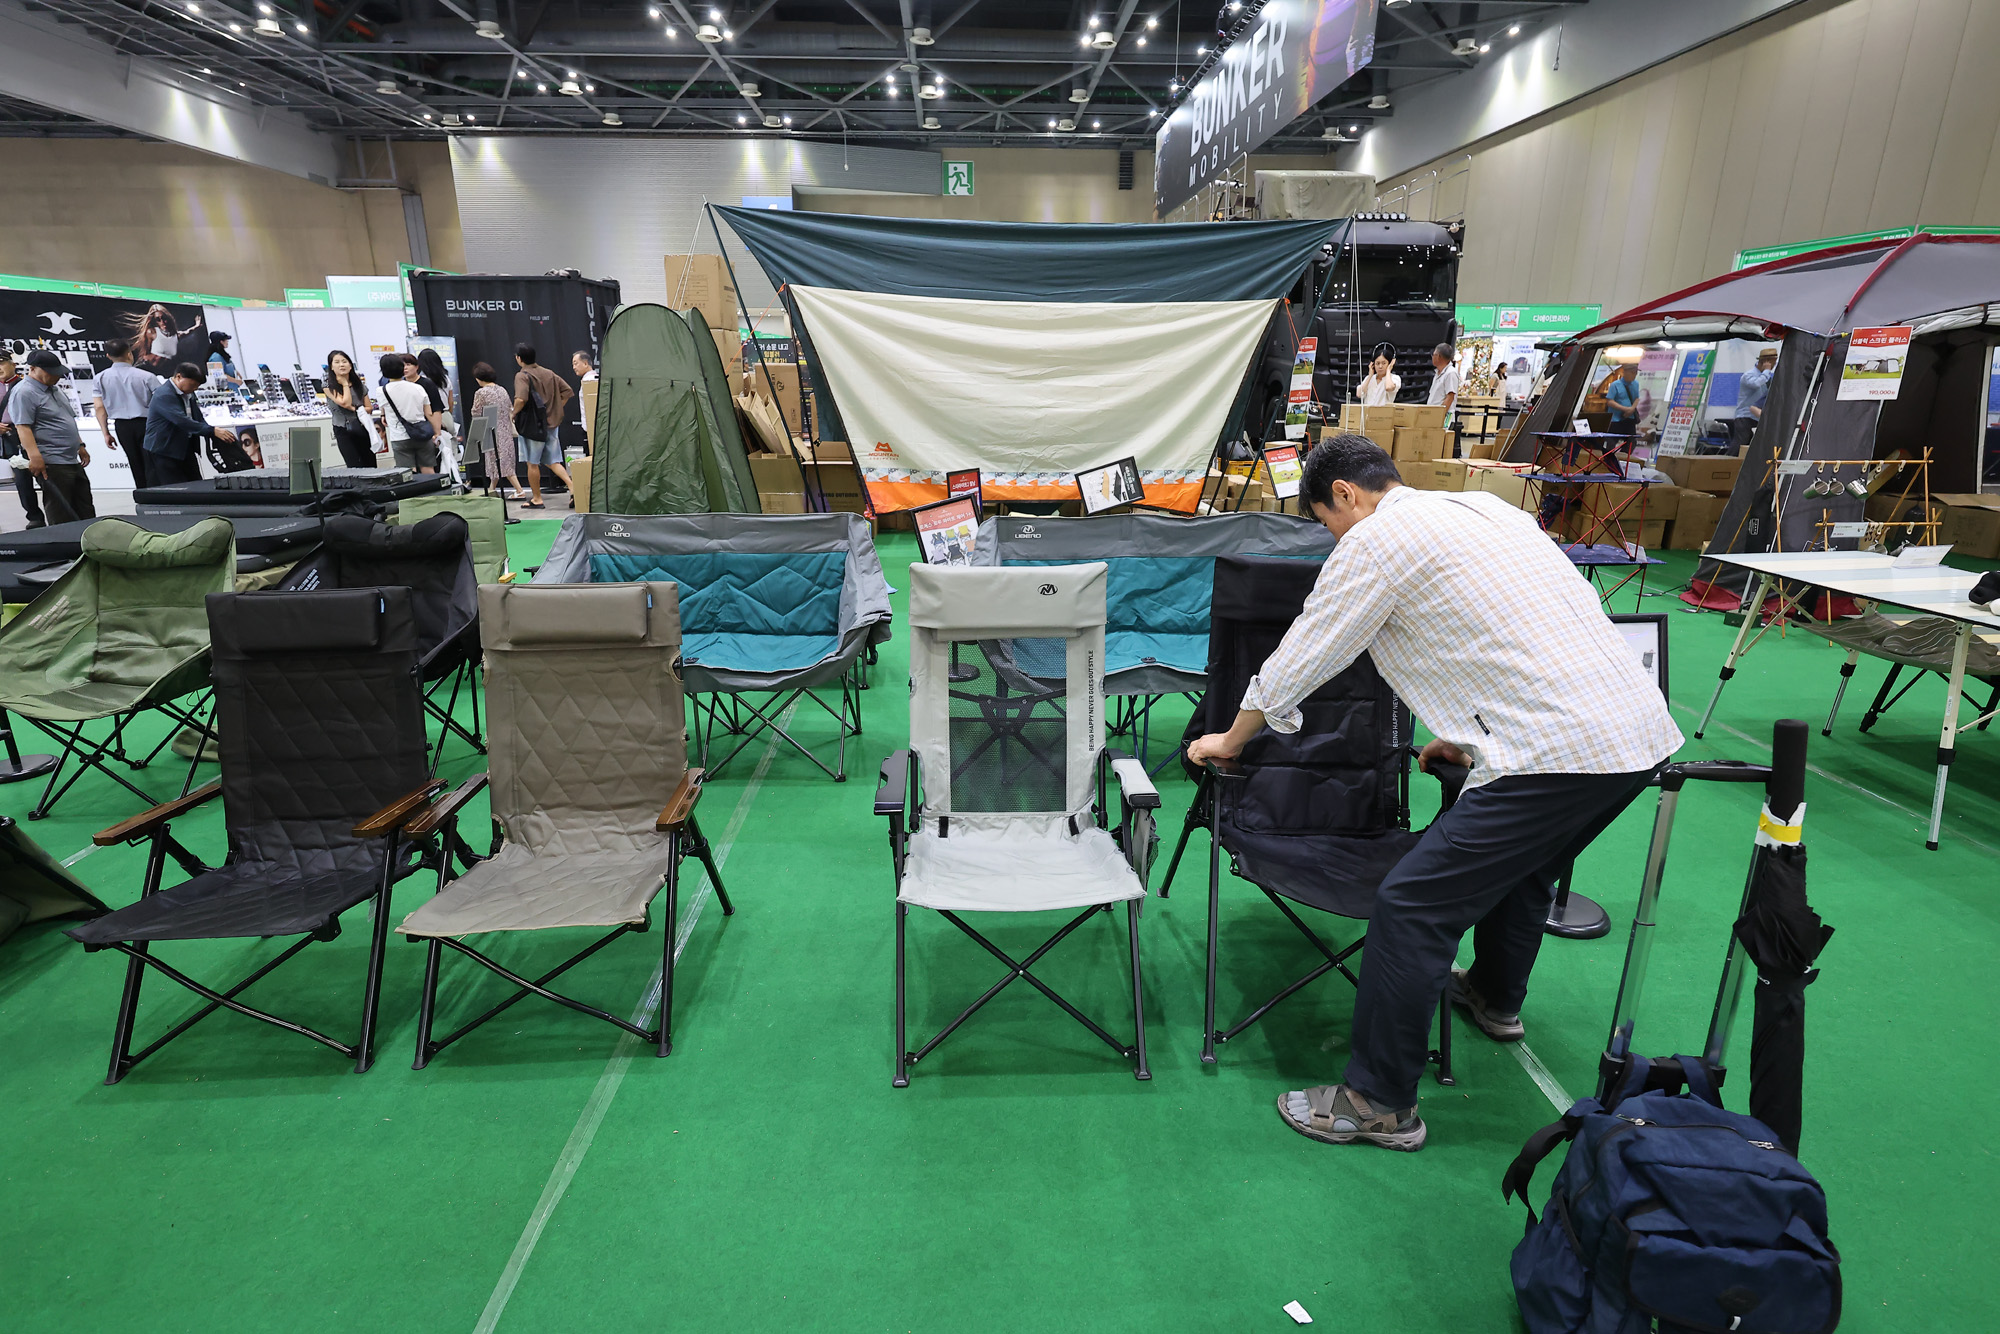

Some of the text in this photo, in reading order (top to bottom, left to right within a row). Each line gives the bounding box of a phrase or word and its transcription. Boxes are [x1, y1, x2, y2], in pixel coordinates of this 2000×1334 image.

[1190, 14, 1288, 157] BUNKER
[1189, 88, 1283, 188] MOBILITY
[446, 300, 523, 311] BUNKER 01
